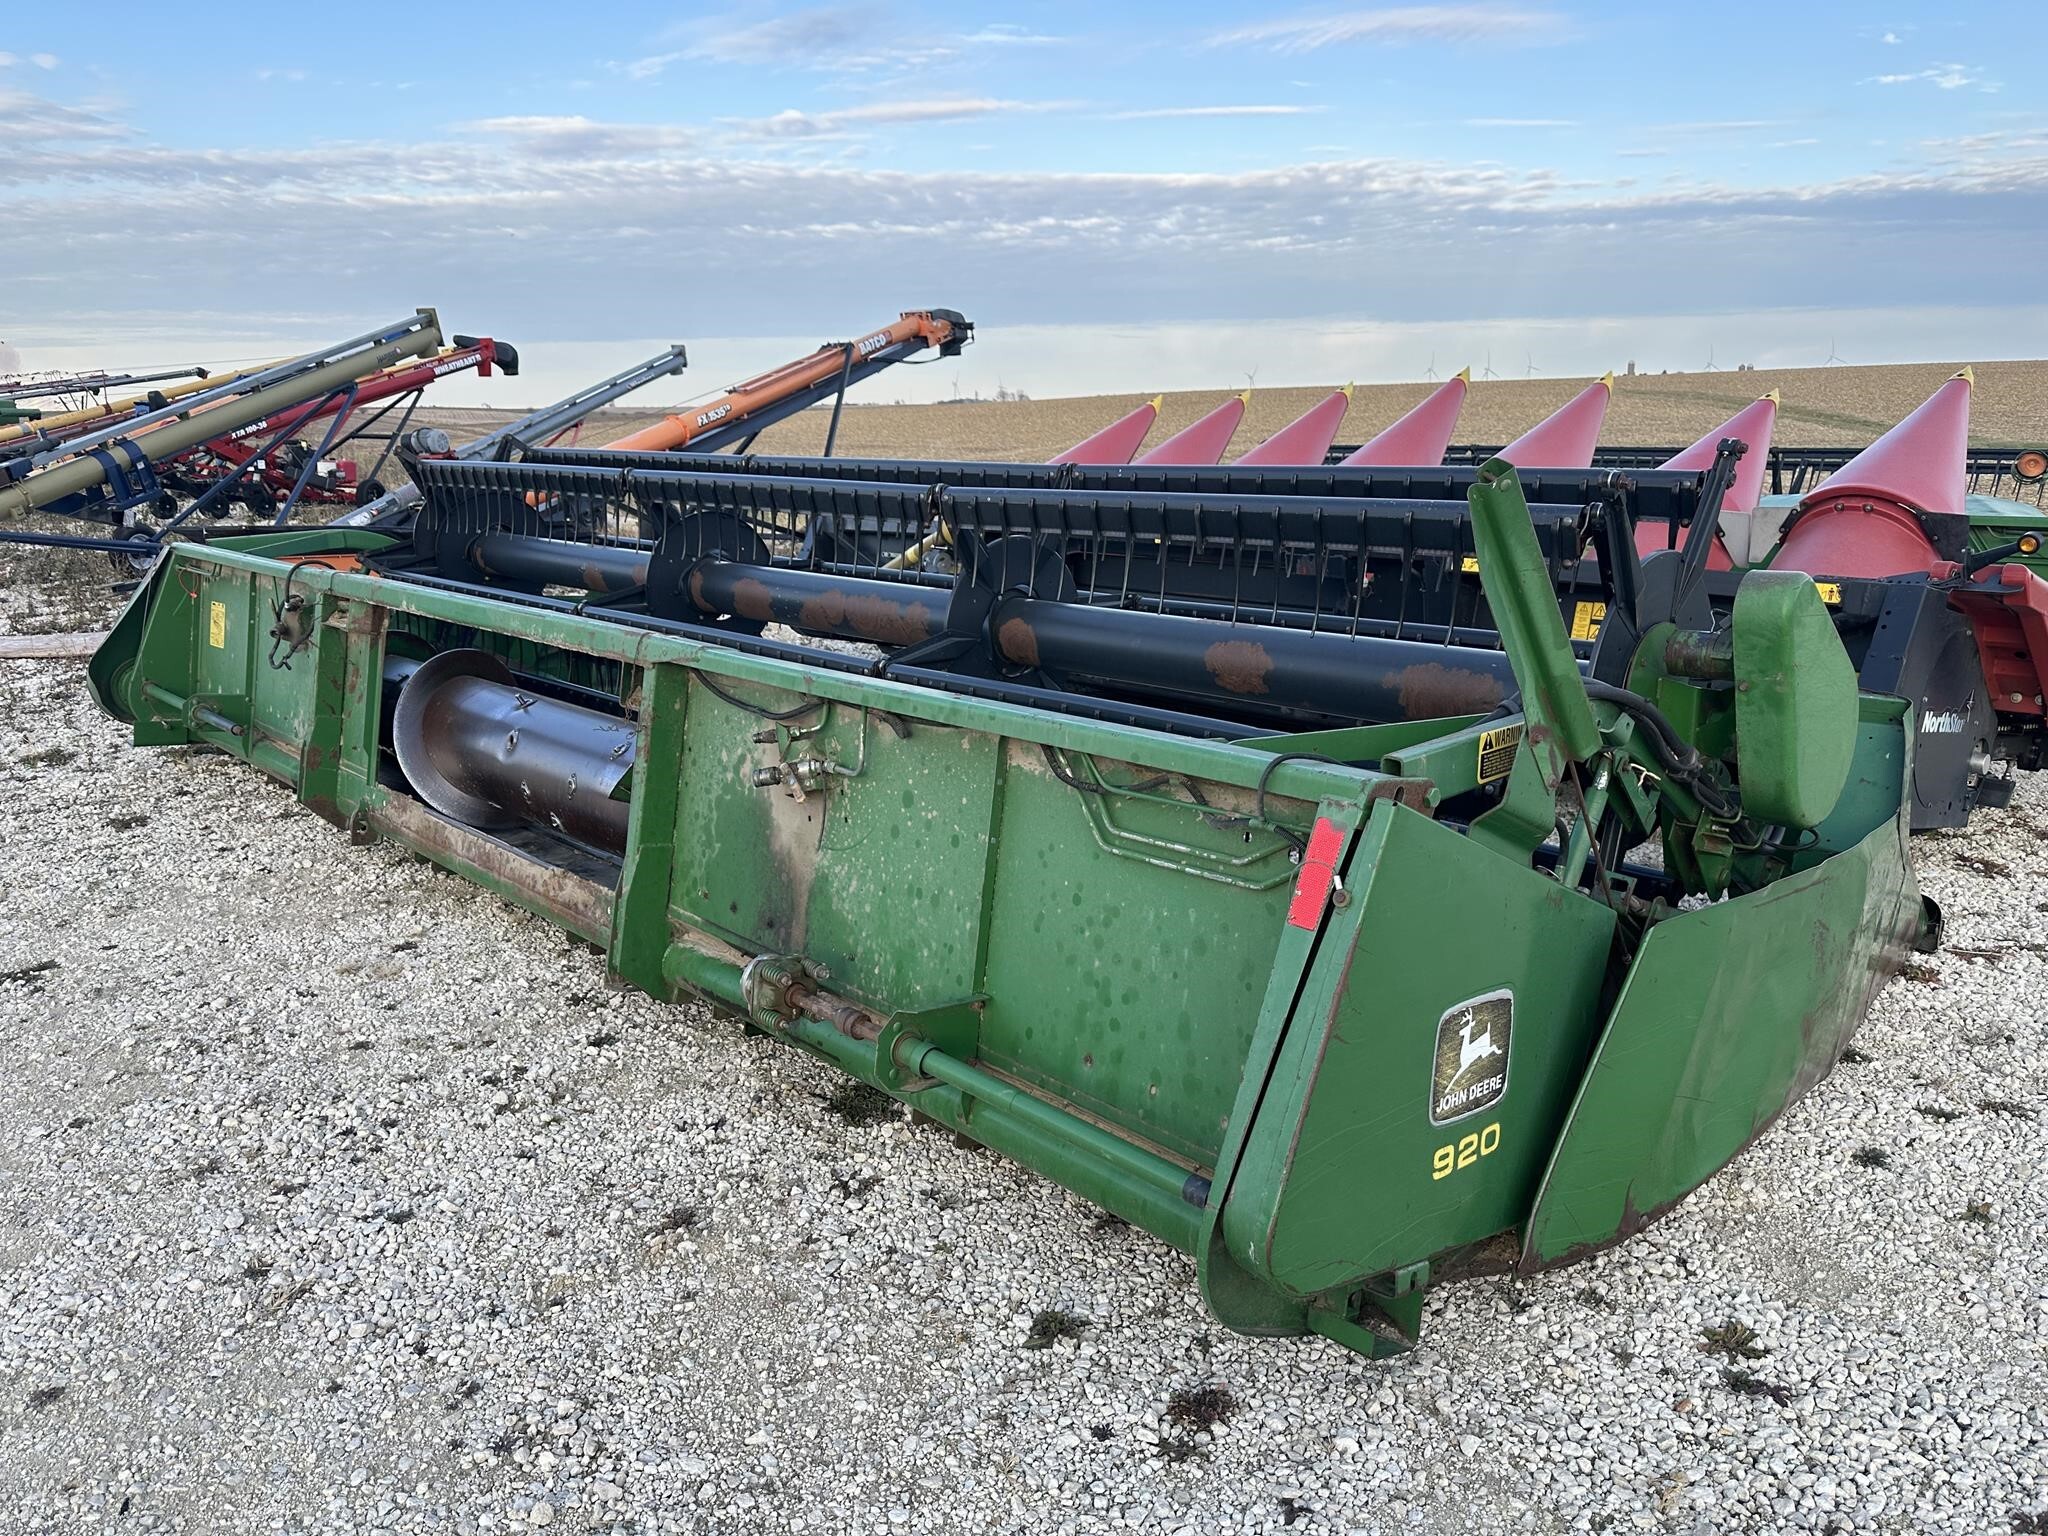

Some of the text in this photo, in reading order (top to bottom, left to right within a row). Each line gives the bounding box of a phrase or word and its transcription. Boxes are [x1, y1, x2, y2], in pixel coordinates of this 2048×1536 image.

[1494, 724, 1522, 748] WARNIN
[1921, 711, 1966, 733] NorthStar
[1435, 1073, 1504, 1114] JOHN DEERE
[1431, 1121, 1502, 1182] 920
